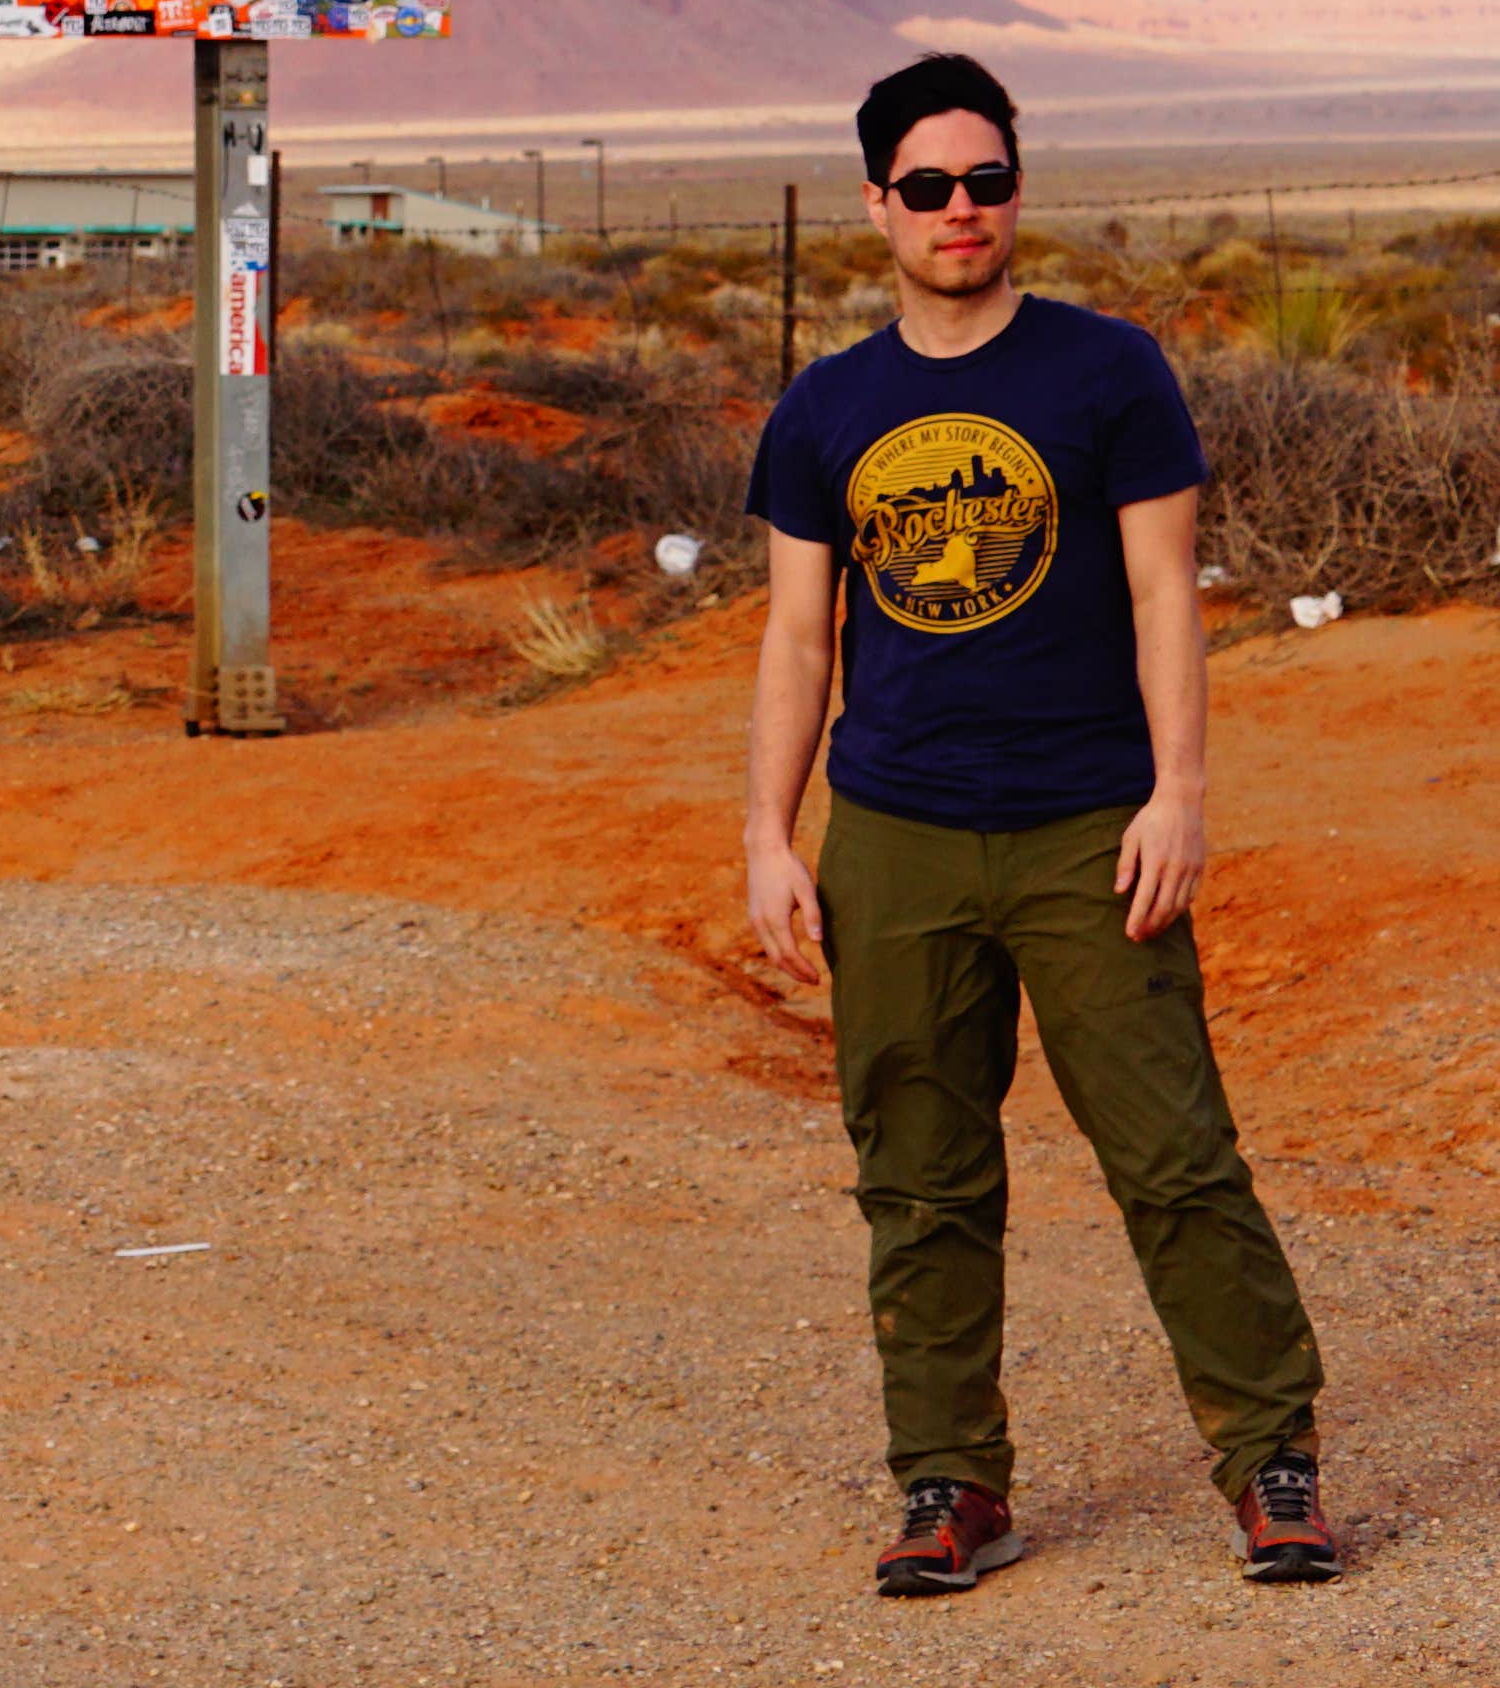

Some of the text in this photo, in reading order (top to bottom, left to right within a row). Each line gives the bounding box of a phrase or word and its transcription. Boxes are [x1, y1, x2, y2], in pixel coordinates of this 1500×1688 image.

[228, 273, 247, 376] america
[859, 424, 1031, 498] IT'S WHERE MY STORY BEGINS
[852, 486, 1050, 571] Rochester
[904, 588, 1004, 618] NEW YORK
